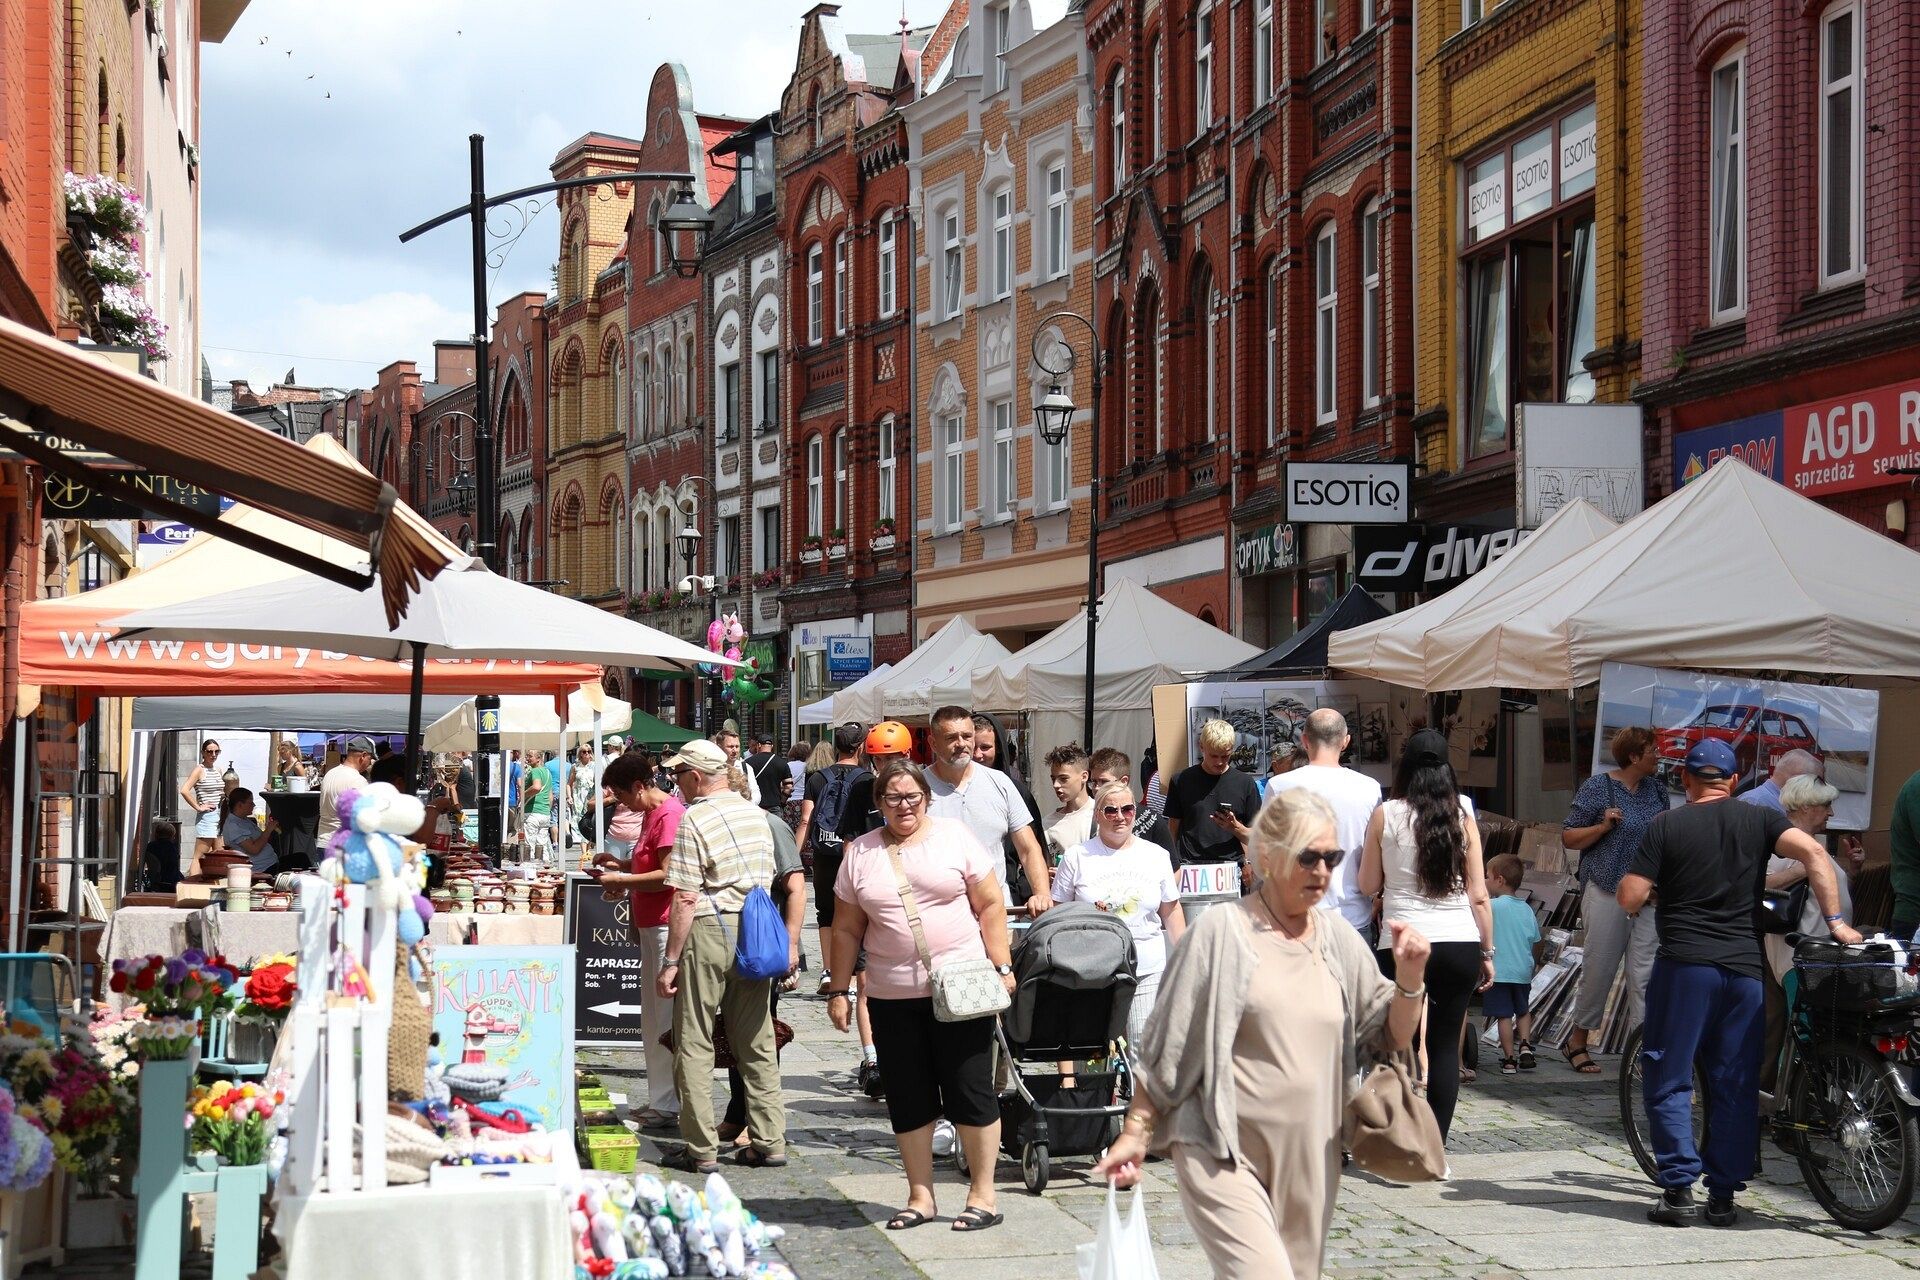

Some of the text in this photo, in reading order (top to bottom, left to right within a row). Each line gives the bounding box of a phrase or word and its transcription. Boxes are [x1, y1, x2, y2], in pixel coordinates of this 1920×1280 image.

[1801, 401, 1876, 465] AGD
[1794, 459, 1855, 490] sprzedaż
[1237, 535, 1271, 570] OPTYK
[1180, 868, 1210, 893] ATA
[592, 928, 628, 946] KAN
[586, 1025, 642, 1036] kantor-prome
